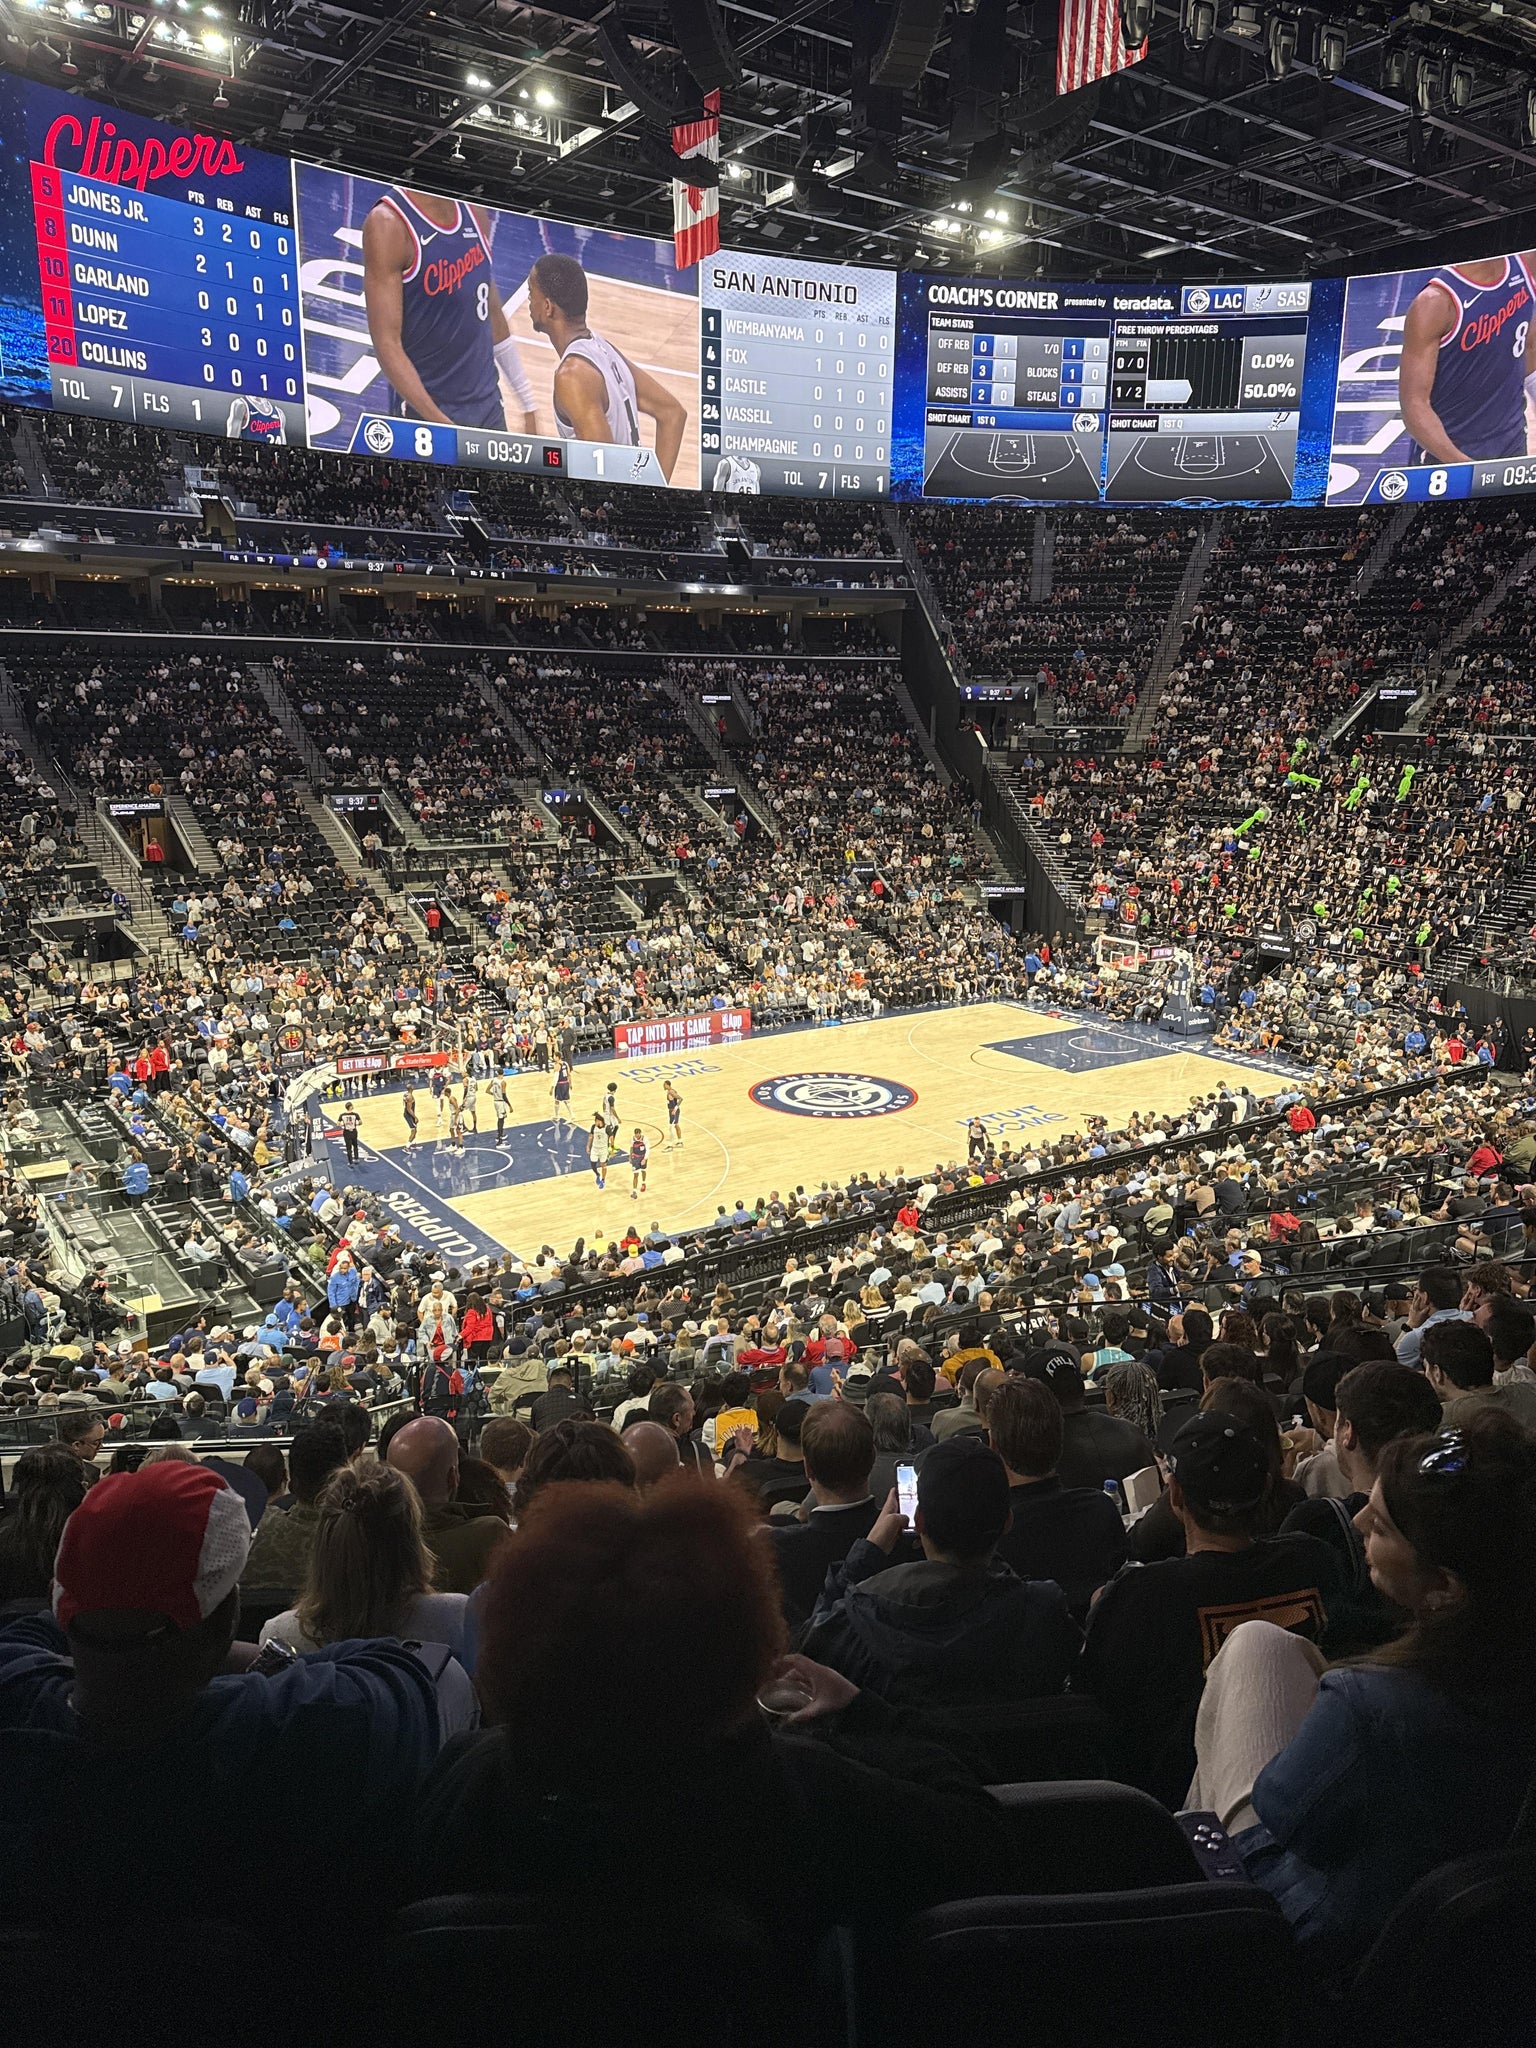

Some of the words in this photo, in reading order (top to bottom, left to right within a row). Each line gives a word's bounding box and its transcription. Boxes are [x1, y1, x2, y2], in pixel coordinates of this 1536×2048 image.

[43, 114, 246, 192] Clippers
[41, 176, 53, 196] 5
[68, 184, 121, 214] JONES
[123, 199, 149, 222] JR.
[193, 217, 204, 236] 3
[222, 224, 233, 243] 2
[250, 230, 261, 250] 0
[277, 237, 288, 256] 0
[188, 190, 205, 205] PTS
[217, 198, 234, 213] REB
[245, 205, 262, 220] AST
[274, 212, 289, 226] FLS
[44, 217, 57, 237] 8
[71, 224, 119, 253] DUNN
[196, 255, 207, 273] 2
[226, 261, 234, 279] 1
[253, 276, 263, 295] 0
[281, 273, 288, 291] 1
[423, 242, 487, 296] Clippers
[44, 257, 64, 277] 10
[75, 264, 150, 297] GARLAND
[256, 303, 263, 320] 1
[712, 268, 755, 293] SAN
[761, 275, 858, 306] ANTONIO
[476, 283, 489, 321] 8
[996, 289, 1059, 310] CORNER
[1064, 297, 1096, 306] presented
[1097, 298, 1106, 308] by
[1113, 296, 1174, 311] teradata.
[1214, 294, 1242, 309] LAC
[1277, 291, 1306, 307] SAS
[49, 296, 66, 316] 11
[78, 302, 128, 330] LOPEZ
[201, 328, 212, 346] 3
[814, 309, 825, 319] PTS
[835, 312, 847, 321] REB
[856, 315, 868, 323] AST
[879, 317, 890, 325] FLS
[932, 318, 951, 328] TEAM
[952, 320, 974, 329] STATS
[1461, 286, 1529, 352] Clippers
[708, 317, 715, 331] 1
[725, 319, 805, 341] WEMBANYAMA
[815, 329, 823, 344] 0
[838, 332, 844, 346] 1
[1117, 326, 1136, 335] FREE
[1137, 326, 1164, 334] THROW
[1165, 325, 1219, 334] PERCENTAGES
[1513, 321, 1529, 358] 8
[938, 338, 954, 349] OFF
[956, 339, 970, 349] REB
[980, 341, 987, 352] 0
[1044, 343, 1059, 354] T/O
[1071, 345, 1076, 356] 1
[50, 336, 72, 356] 20
[81, 341, 147, 371] COLLINS
[260, 374, 268, 391] 1
[706, 346, 715, 360] 4
[725, 348, 747, 364] FOX
[816, 358, 821, 371] 1
[937, 362, 953, 373] DEF
[954, 364, 969, 374] REB
[979, 364, 986, 377] 3
[1116, 358, 1125, 369] 0
[1136, 357, 1144, 368] 0
[1251, 354, 1294, 369] 0.0%
[1027, 368, 1058, 378] BLOCKS
[1070, 368, 1074, 380] 1
[59, 378, 90, 401] TOL
[111, 385, 123, 408] 7
[144, 393, 170, 413] FLS
[191, 399, 201, 420] 1
[707, 376, 715, 390] 5
[725, 377, 767, 395] CASTLE
[814, 386, 822, 400] 0
[837, 389, 842, 402] 1
[857, 390, 864, 403] 0
[879, 392, 884, 405] 1
[935, 386, 968, 398] ASSISTS
[978, 388, 985, 400] 2
[1027, 391, 1057, 401] STEALS
[1067, 392, 1074, 403] 0
[1116, 386, 1122, 398] 1
[1135, 385, 1142, 397] 2
[1244, 383, 1296, 399] 50.0%
[703, 404, 719, 419] 24
[725, 406, 772, 424] VASSELL
[928, 413, 947, 423] SHOT
[948, 415, 971, 424] CHART
[977, 416, 989, 425] 1ST
[990, 416, 996, 426] Q
[1112, 419, 1131, 428] SHOT
[1132, 419, 1157, 428] CHART
[1164, 419, 1176, 428] 1ST
[1177, 419, 1183, 428] Q
[251, 420, 281, 434] Clippers
[414, 427, 434, 457] 8
[465, 441, 480, 455] 1ST
[487, 440, 533, 464] 09:37
[547, 451, 559, 465] 15
[591, 448, 605, 475] 1
[703, 433, 719, 447] 30
[725, 435, 798, 455] CHAMPAGNIE
[784, 471, 803, 485] TOL
[818, 473, 828, 489] 7
[841, 475, 860, 489] FLS
[876, 476, 883, 492] 1
[1428, 470, 1448, 496] 8
[1481, 473, 1495, 486] 1ST
[368, 562, 384, 571] 9:37
[349, 797, 363, 805] 9:37
[626, 1027, 643, 1045] TAP
[645, 1023, 666, 1041] INTO
[668, 1021, 685, 1039] THE
[687, 1017, 711, 1037] GAME
[729, 1013, 743, 1030] App
[289, 1038, 298, 1047] 15
[342, 1061, 352, 1070] GET
[355, 1059, 366, 1069] THE
[618, 1059, 705, 1077] INTUIT
[1207, 1049, 1315, 1079] CLIPPER
[759, 1086, 772, 1100] LOS
[774, 1073, 873, 1084] ANGELES
[813, 1094, 909, 1117] CLIPPERS
[273, 1175, 328, 1194] coinse
[380, 1191, 478, 1257] CLIPPERS
